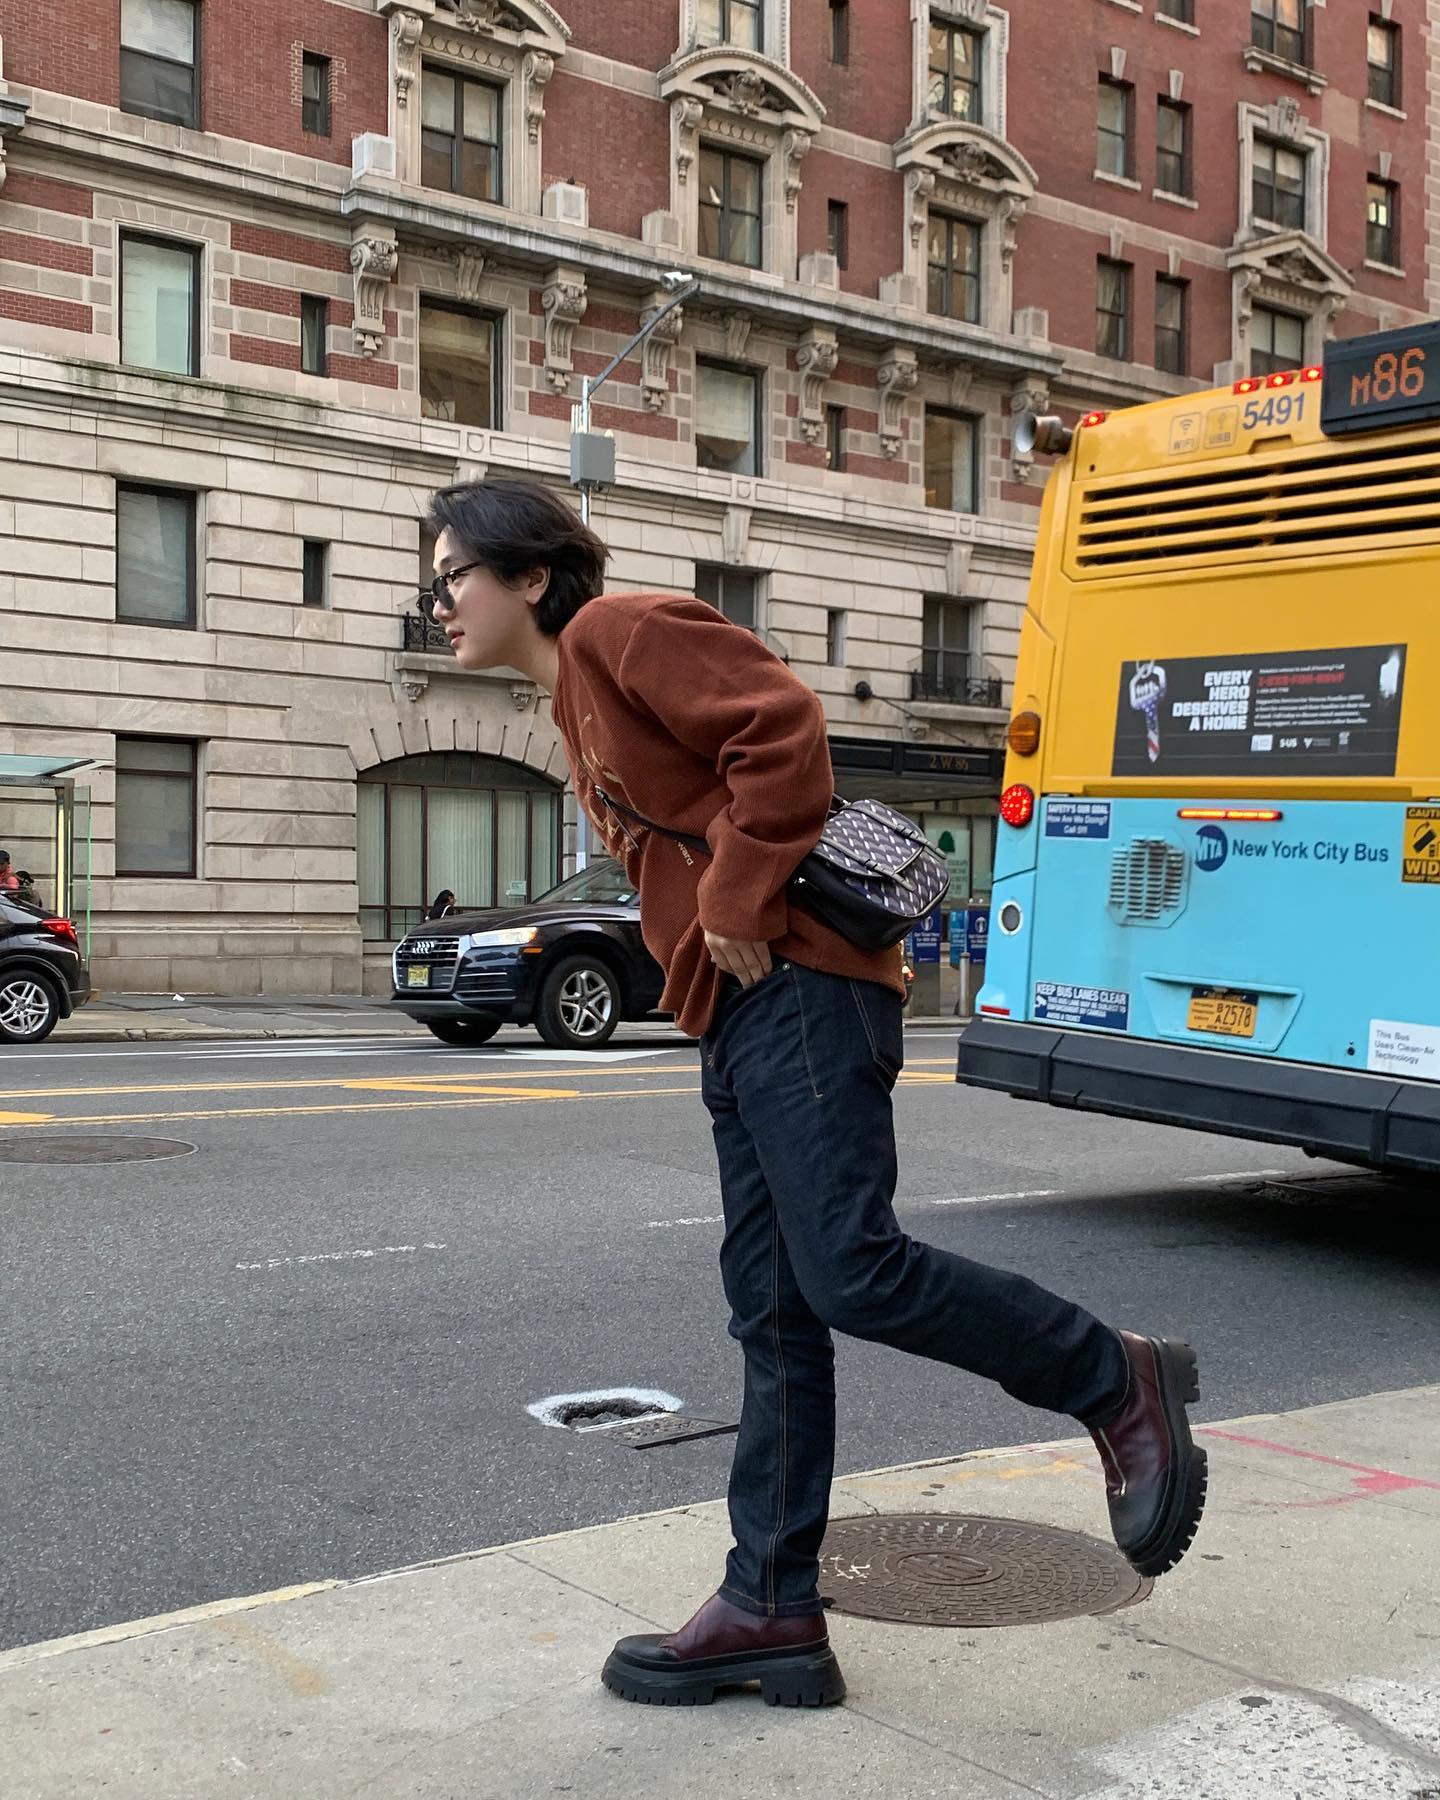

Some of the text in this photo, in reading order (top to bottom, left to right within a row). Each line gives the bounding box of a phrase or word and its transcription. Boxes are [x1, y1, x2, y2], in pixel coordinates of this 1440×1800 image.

[1350, 347, 1425, 406] M86
[1242, 392, 1305, 430] 5491
[1203, 670, 1253, 687] EVERY
[1208, 685, 1250, 701] HERO
[1172, 700, 1249, 717] DESERVES
[1188, 716, 1200, 731] A
[1202, 715, 1248, 731] HOME
[1195, 836, 1389, 864] MTA New York City Bus
[1037, 983, 1127, 1005] KEEP BUS LANES CLEAR
[1376, 1029, 1410, 1041] This Bus
